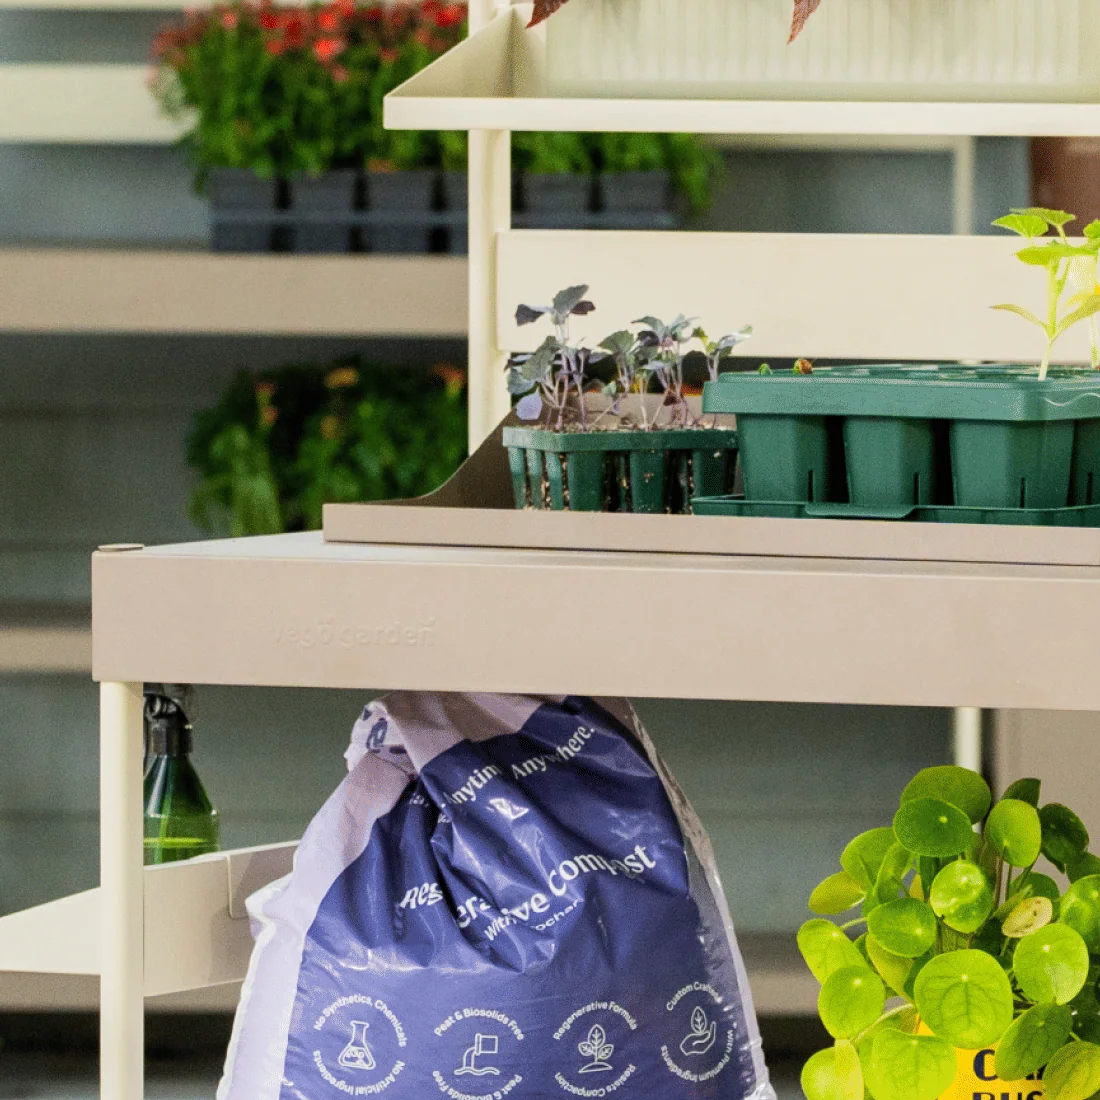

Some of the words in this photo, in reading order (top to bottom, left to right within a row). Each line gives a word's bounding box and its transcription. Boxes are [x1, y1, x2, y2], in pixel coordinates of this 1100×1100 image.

[442, 764, 504, 805] nytim
[666, 983, 693, 1011] Custom
[374, 999, 408, 1048] Chemicals
[433, 1015, 457, 1037] Peat
[462, 1007, 510, 1025] Biosolids
[507, 1019, 525, 1041] Free
[552, 1001, 609, 1040] Regenerative
[608, 1000, 638, 1031] Formula
[312, 1049, 354, 1096] Ingredients
[391, 1060, 406, 1075] No
[432, 1070, 450, 1092] Free
[606, 1063, 637, 1093] Resists
[501, 1074, 523, 1095] Peat
[554, 1071, 606, 1098] Compaction
